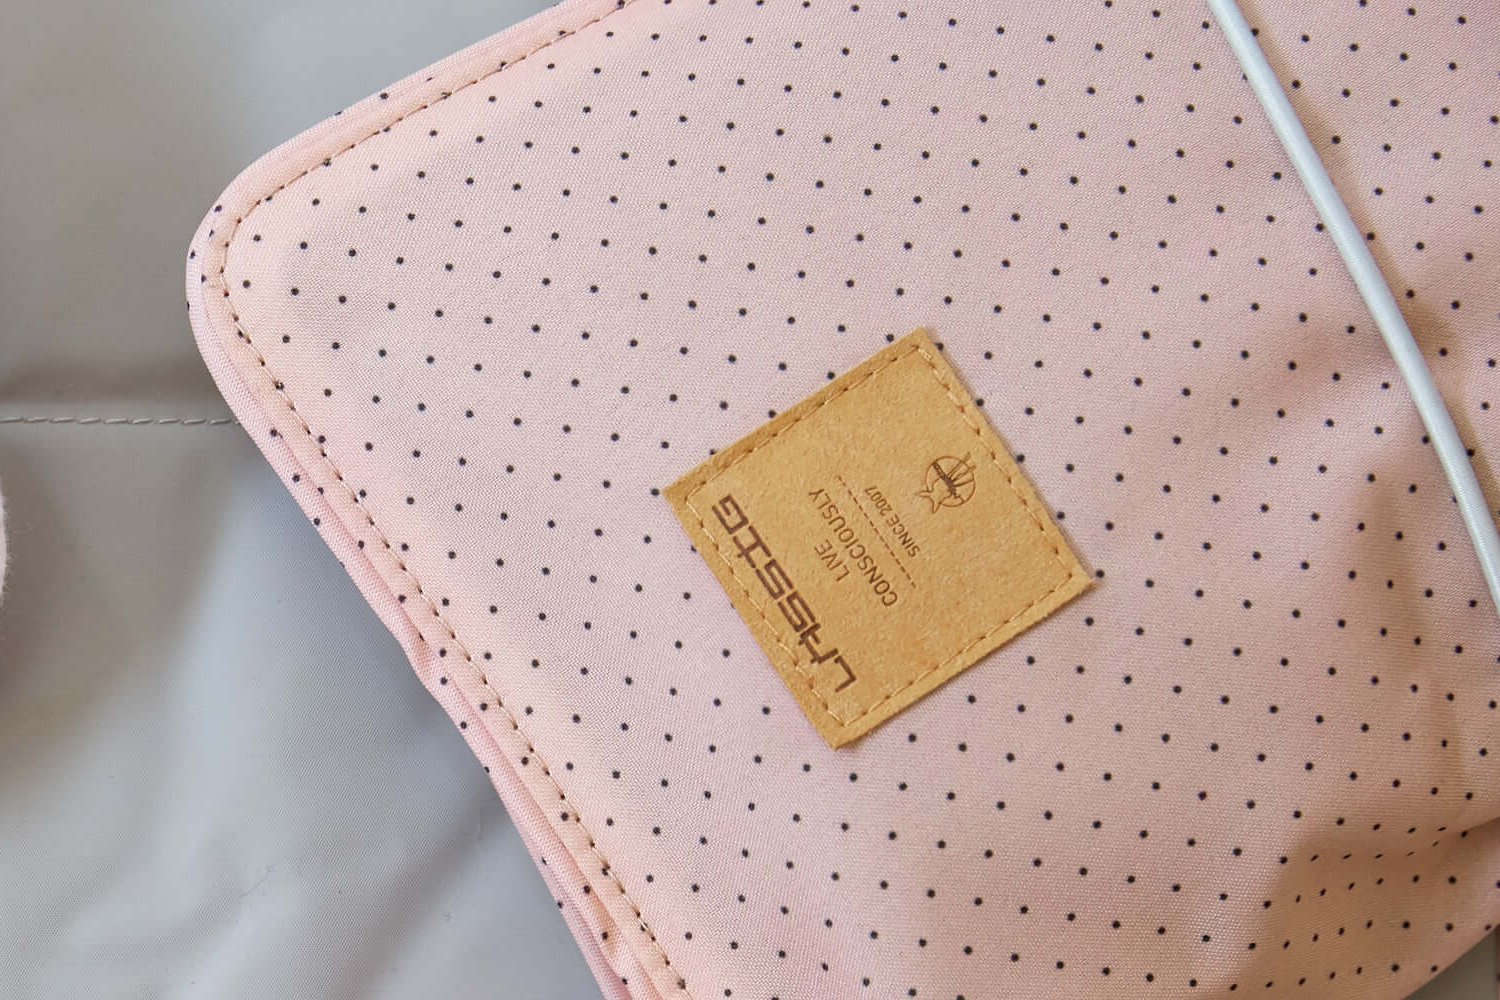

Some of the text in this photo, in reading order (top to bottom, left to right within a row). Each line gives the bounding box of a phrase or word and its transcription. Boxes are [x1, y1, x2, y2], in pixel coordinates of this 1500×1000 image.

[808, 487, 898, 608] CONSCIOUSLY
[863, 485, 920, 559] SINCE 2007
[814, 540, 850, 582] LIVE
